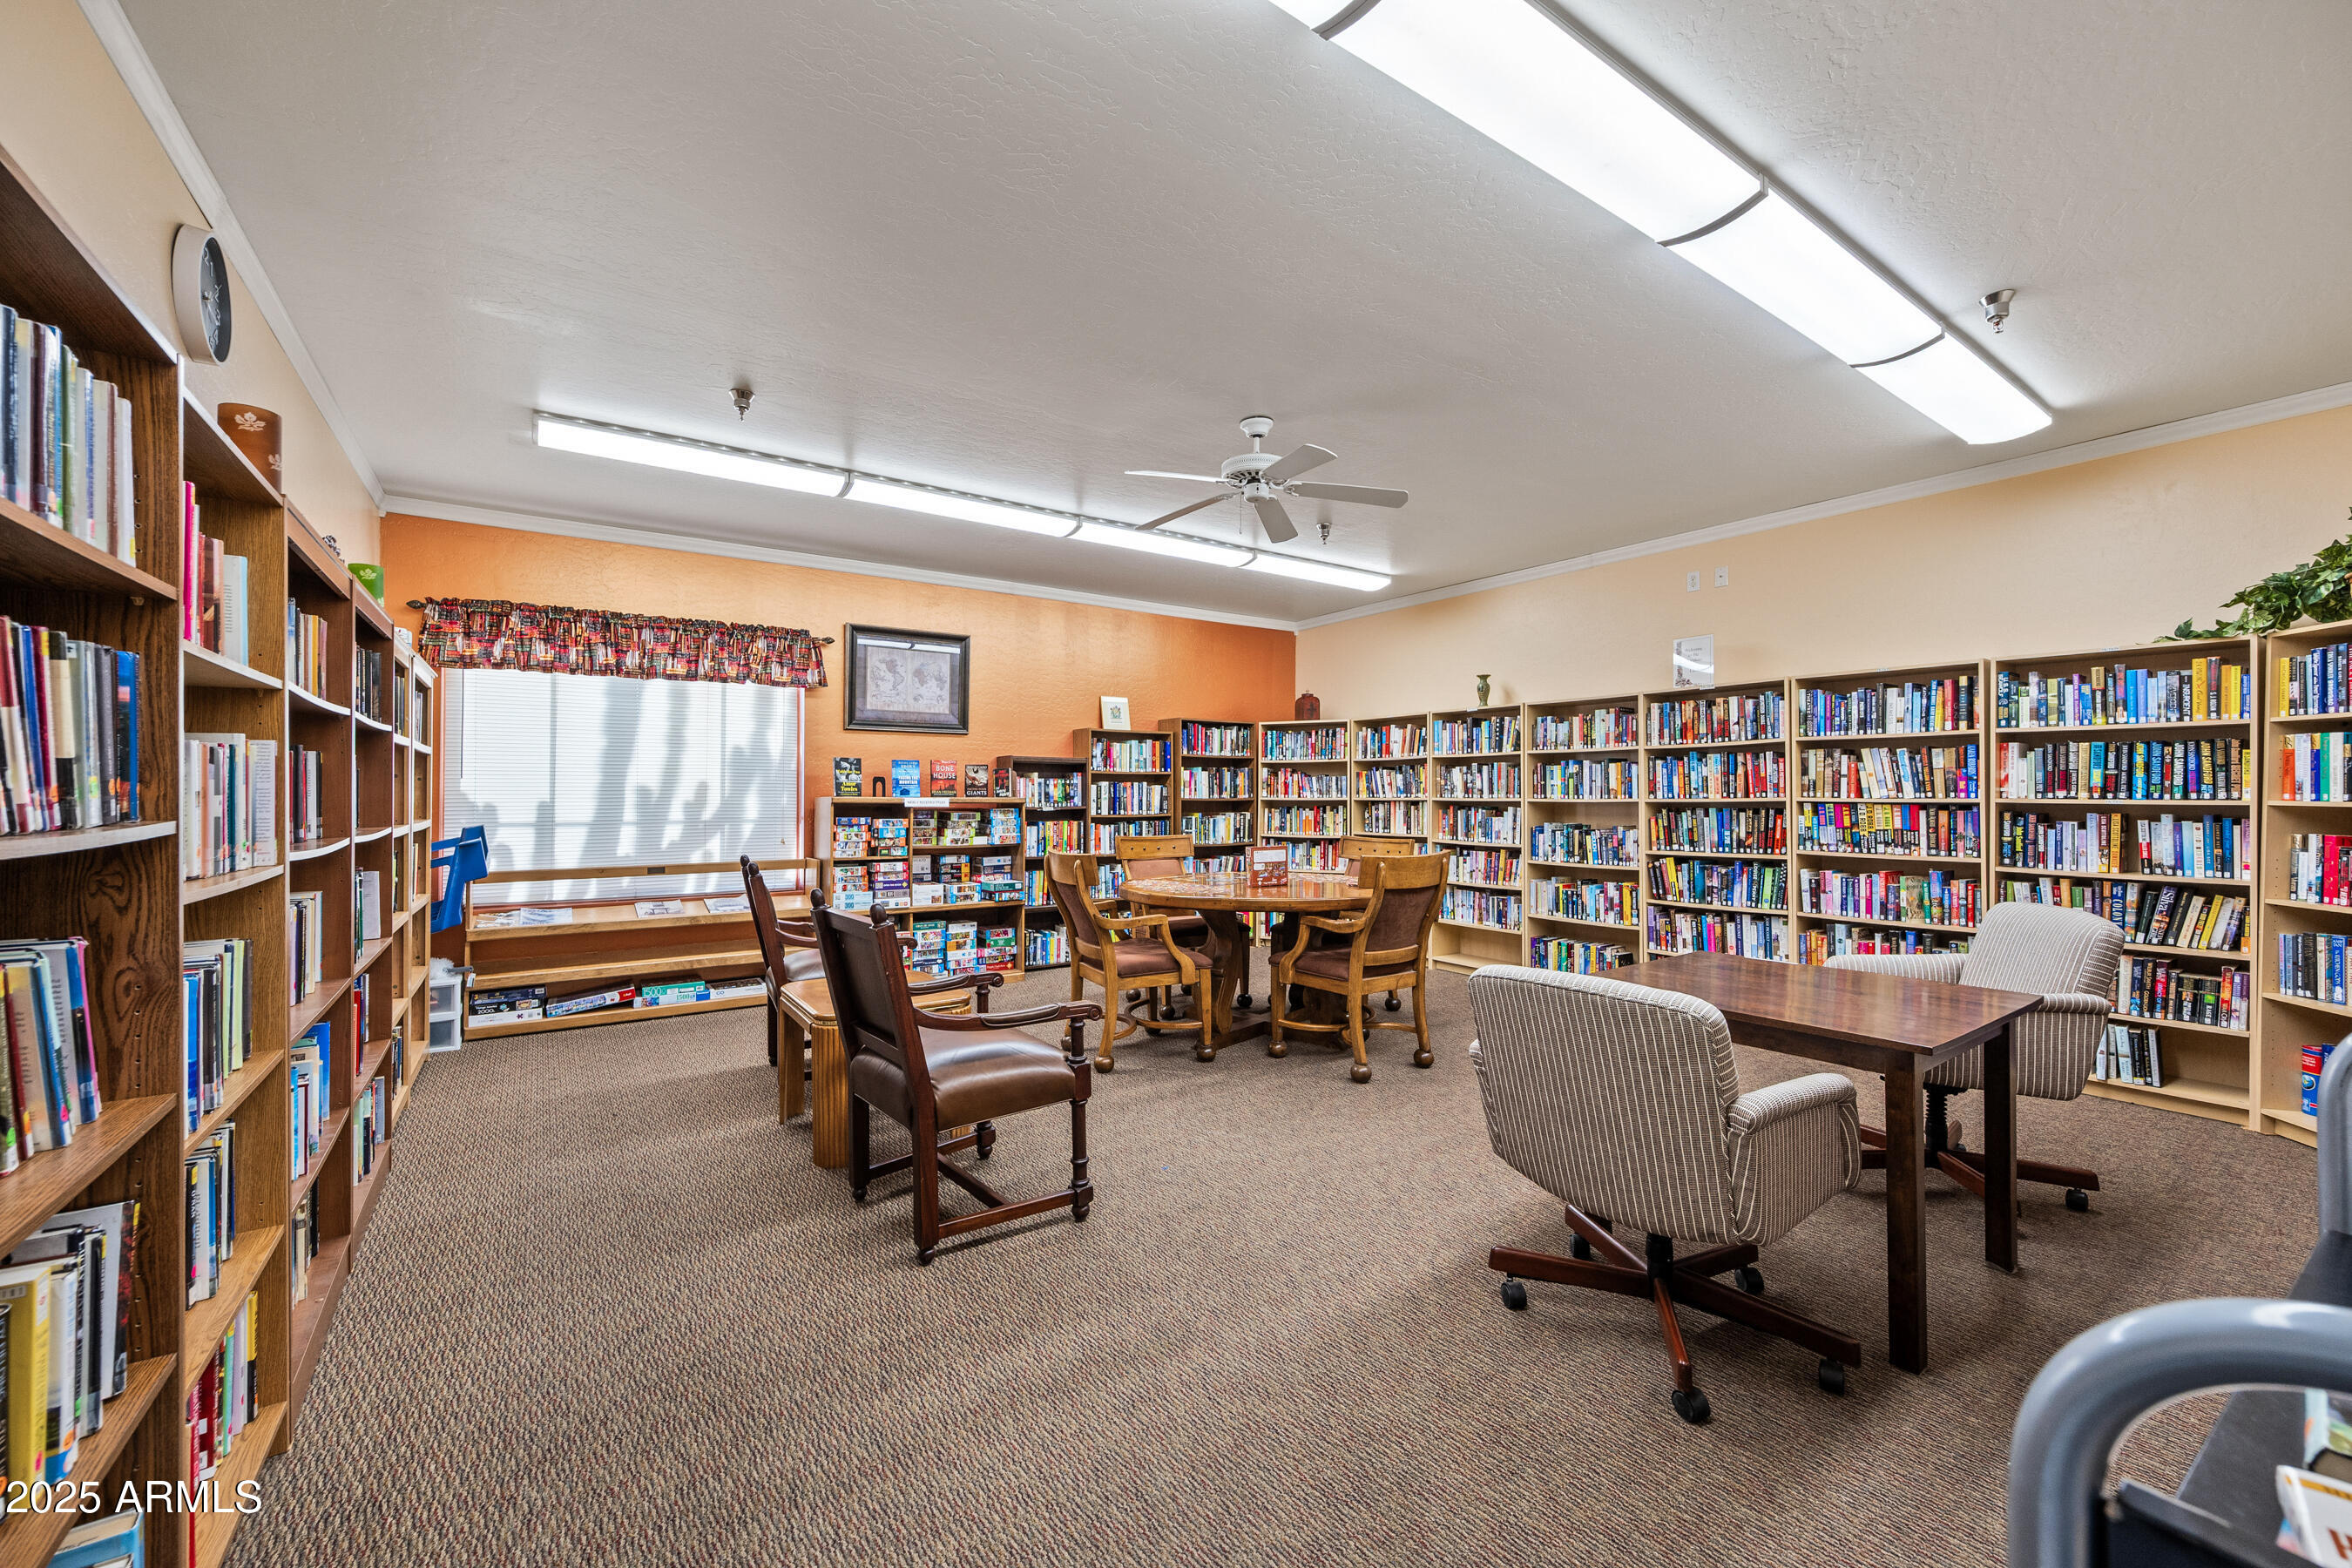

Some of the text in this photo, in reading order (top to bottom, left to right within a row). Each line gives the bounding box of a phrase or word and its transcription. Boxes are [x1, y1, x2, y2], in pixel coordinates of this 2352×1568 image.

[1967, 746, 1977, 774] KAREN ROBARDS
[2135, 742, 2145, 777] JOHN SANDFORD
[2152, 742, 2161, 784] JOHN SANDFORD
[2173, 742, 2184, 785] JOHN SANDFORD
[2201, 741, 2213, 784] JOHN SANDFORD
[2111, 818, 2119, 827] LISA
[2111, 827, 2119, 849] SCOTTOLINE
[2112, 899, 2124, 927] COLONY
[2158, 891, 2175, 911] Silva
